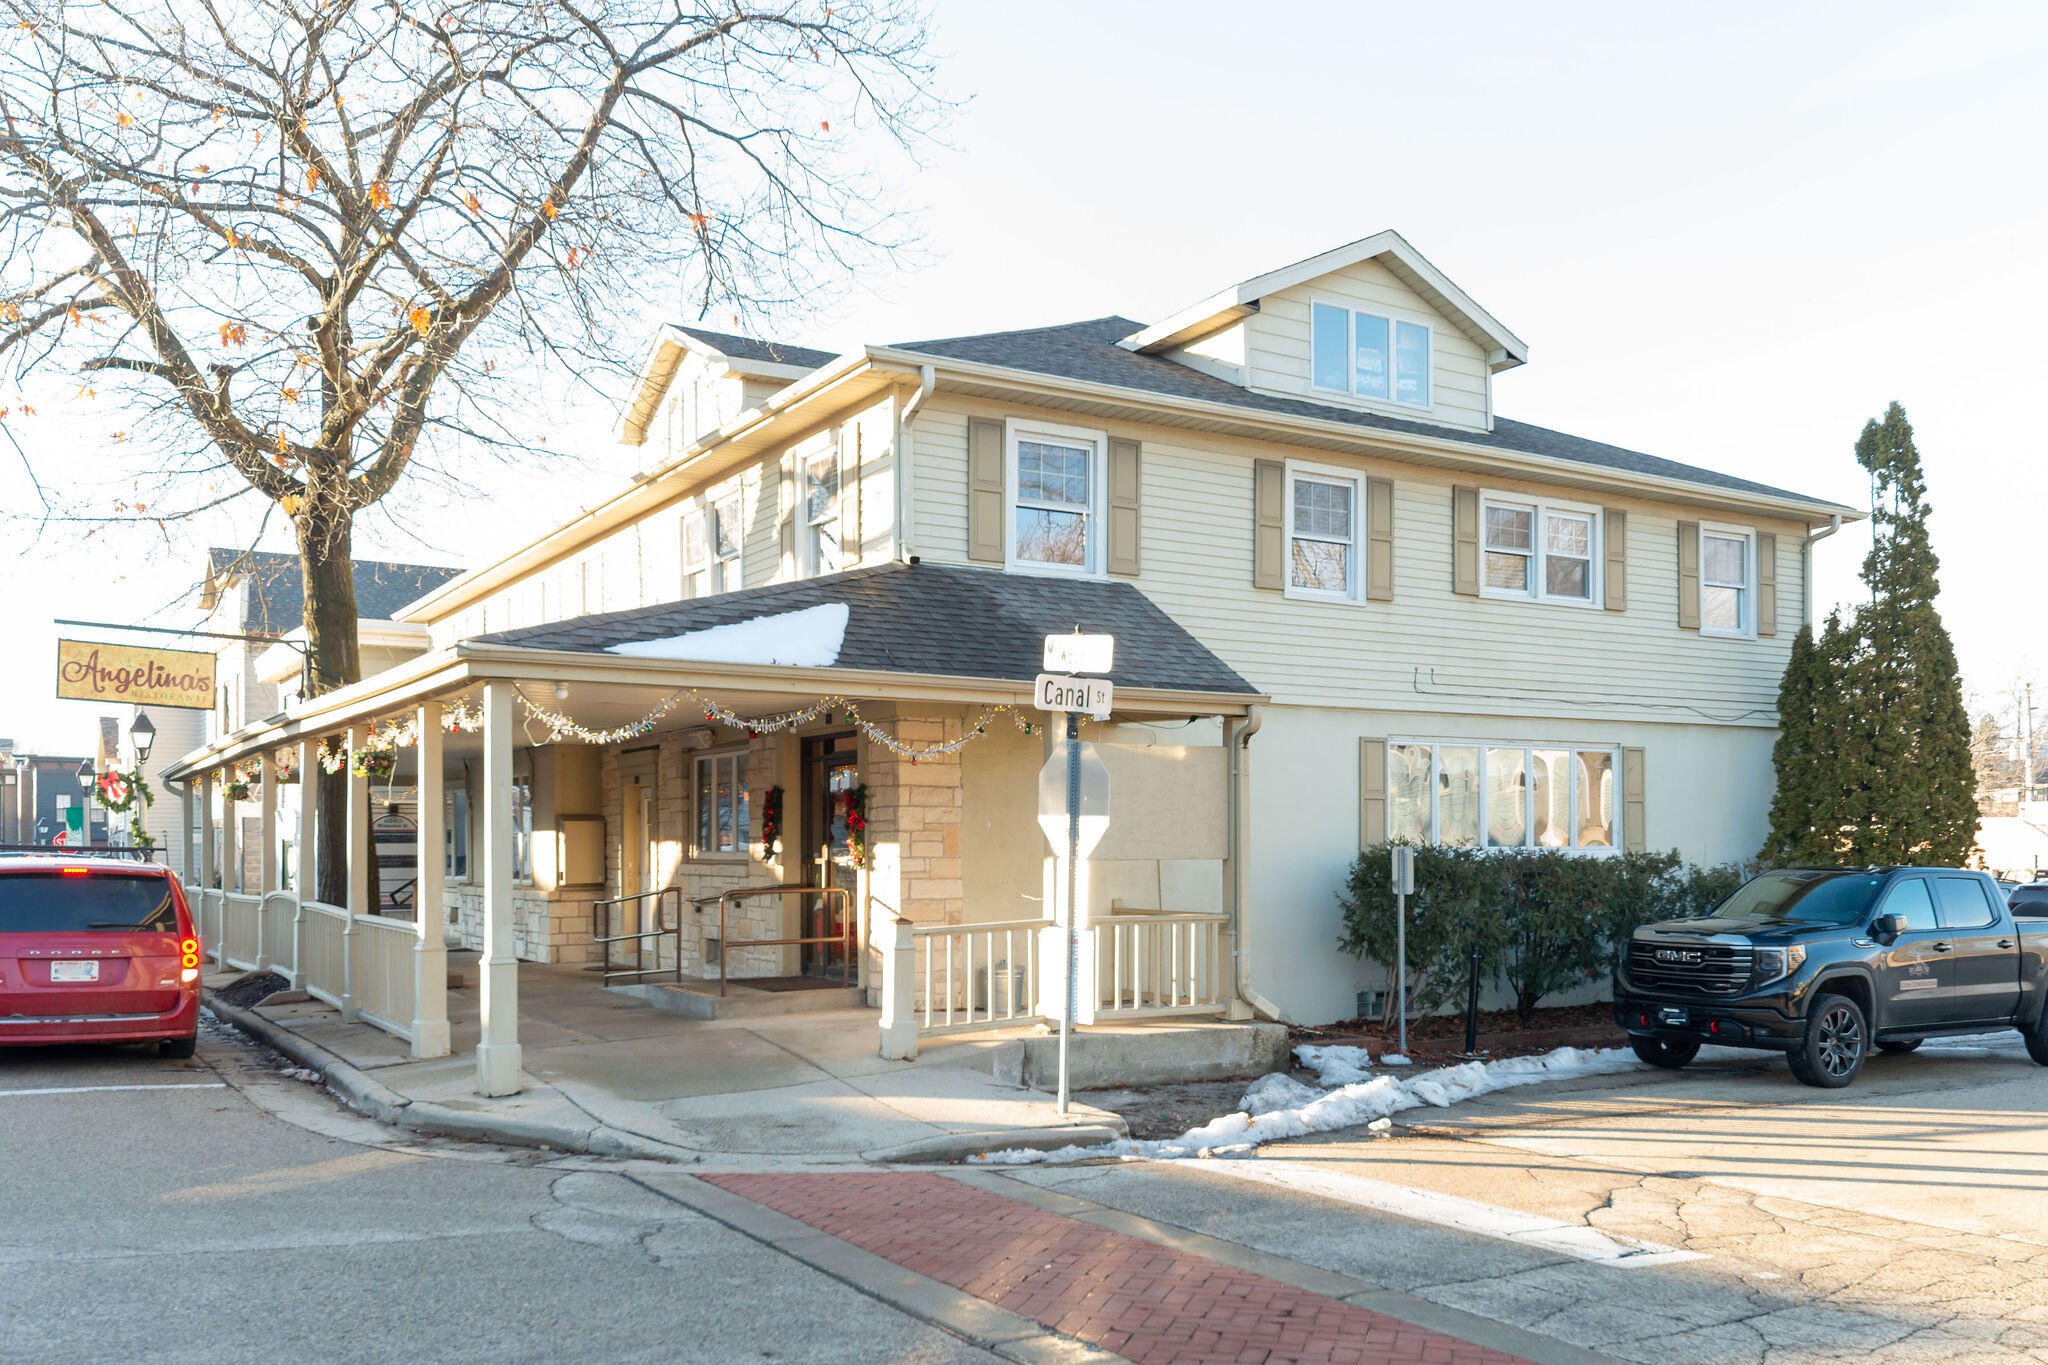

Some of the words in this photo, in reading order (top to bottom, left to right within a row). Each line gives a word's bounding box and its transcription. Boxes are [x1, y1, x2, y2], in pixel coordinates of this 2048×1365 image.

[62, 649, 211, 693] Angelina's
[1044, 680, 1090, 707] Canal
[1655, 949, 1702, 963] GMC
